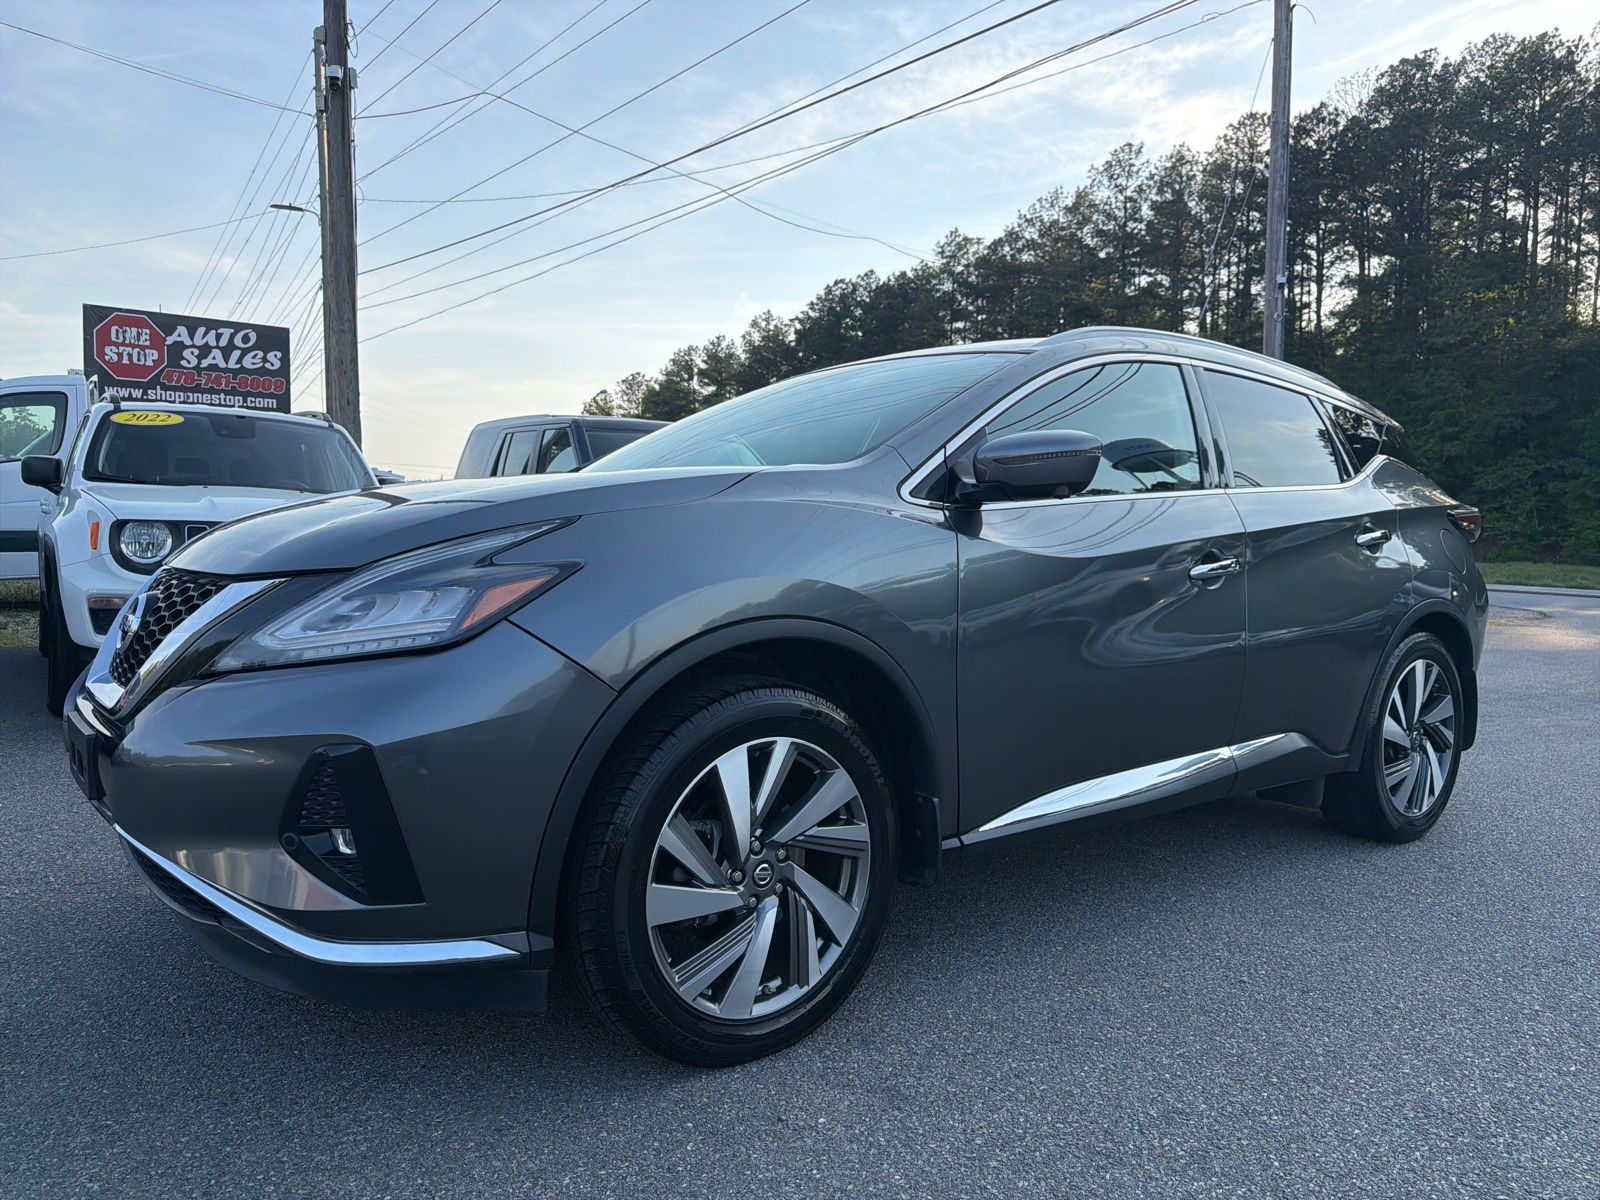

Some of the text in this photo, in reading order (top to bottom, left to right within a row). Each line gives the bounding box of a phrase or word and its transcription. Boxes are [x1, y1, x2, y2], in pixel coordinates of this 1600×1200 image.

[110, 325, 151, 346] ONE
[164, 325, 257, 348] AUTO
[104, 345, 159, 367] STOP
[124, 413, 172, 423] 2022
